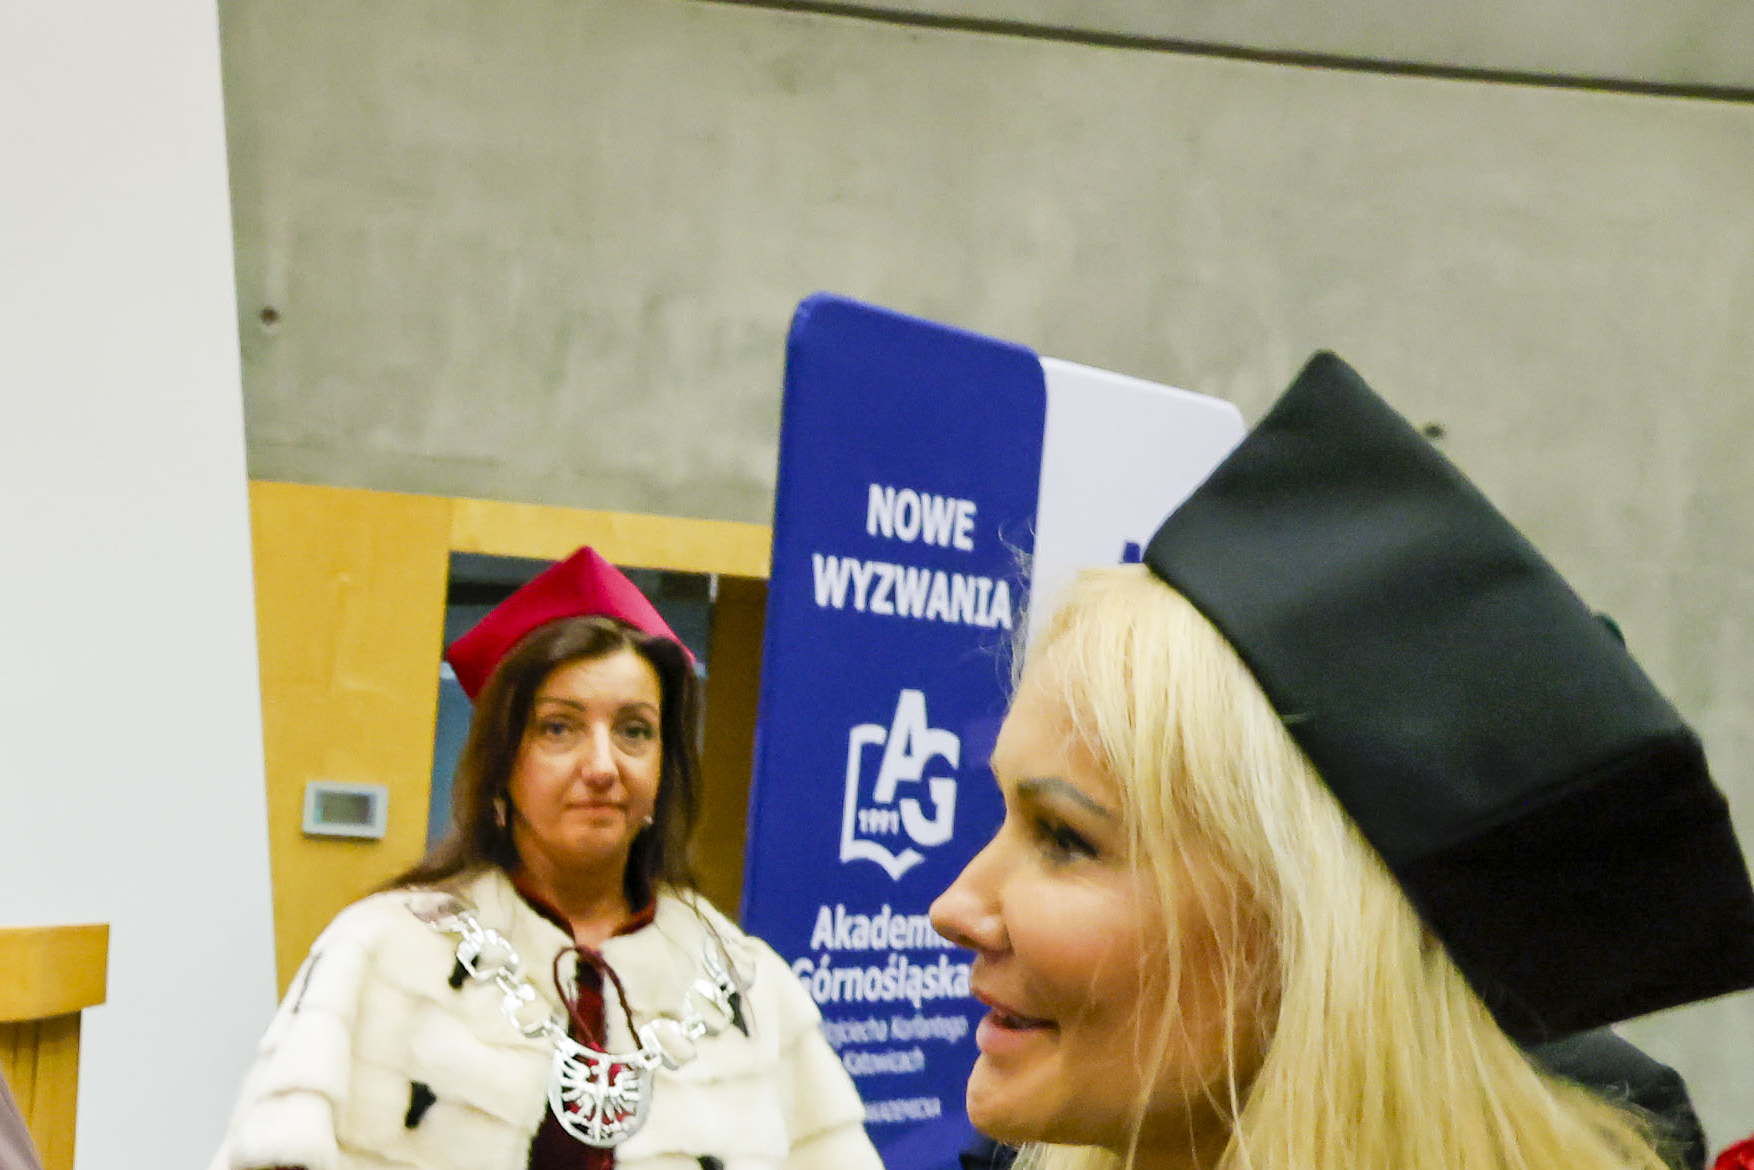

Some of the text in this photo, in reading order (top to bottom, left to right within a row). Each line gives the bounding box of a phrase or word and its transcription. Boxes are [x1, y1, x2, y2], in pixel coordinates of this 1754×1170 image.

[867, 484, 977, 551] NOWE
[812, 554, 1012, 629] WYZWANIA
[810, 903, 956, 951] Akadem
